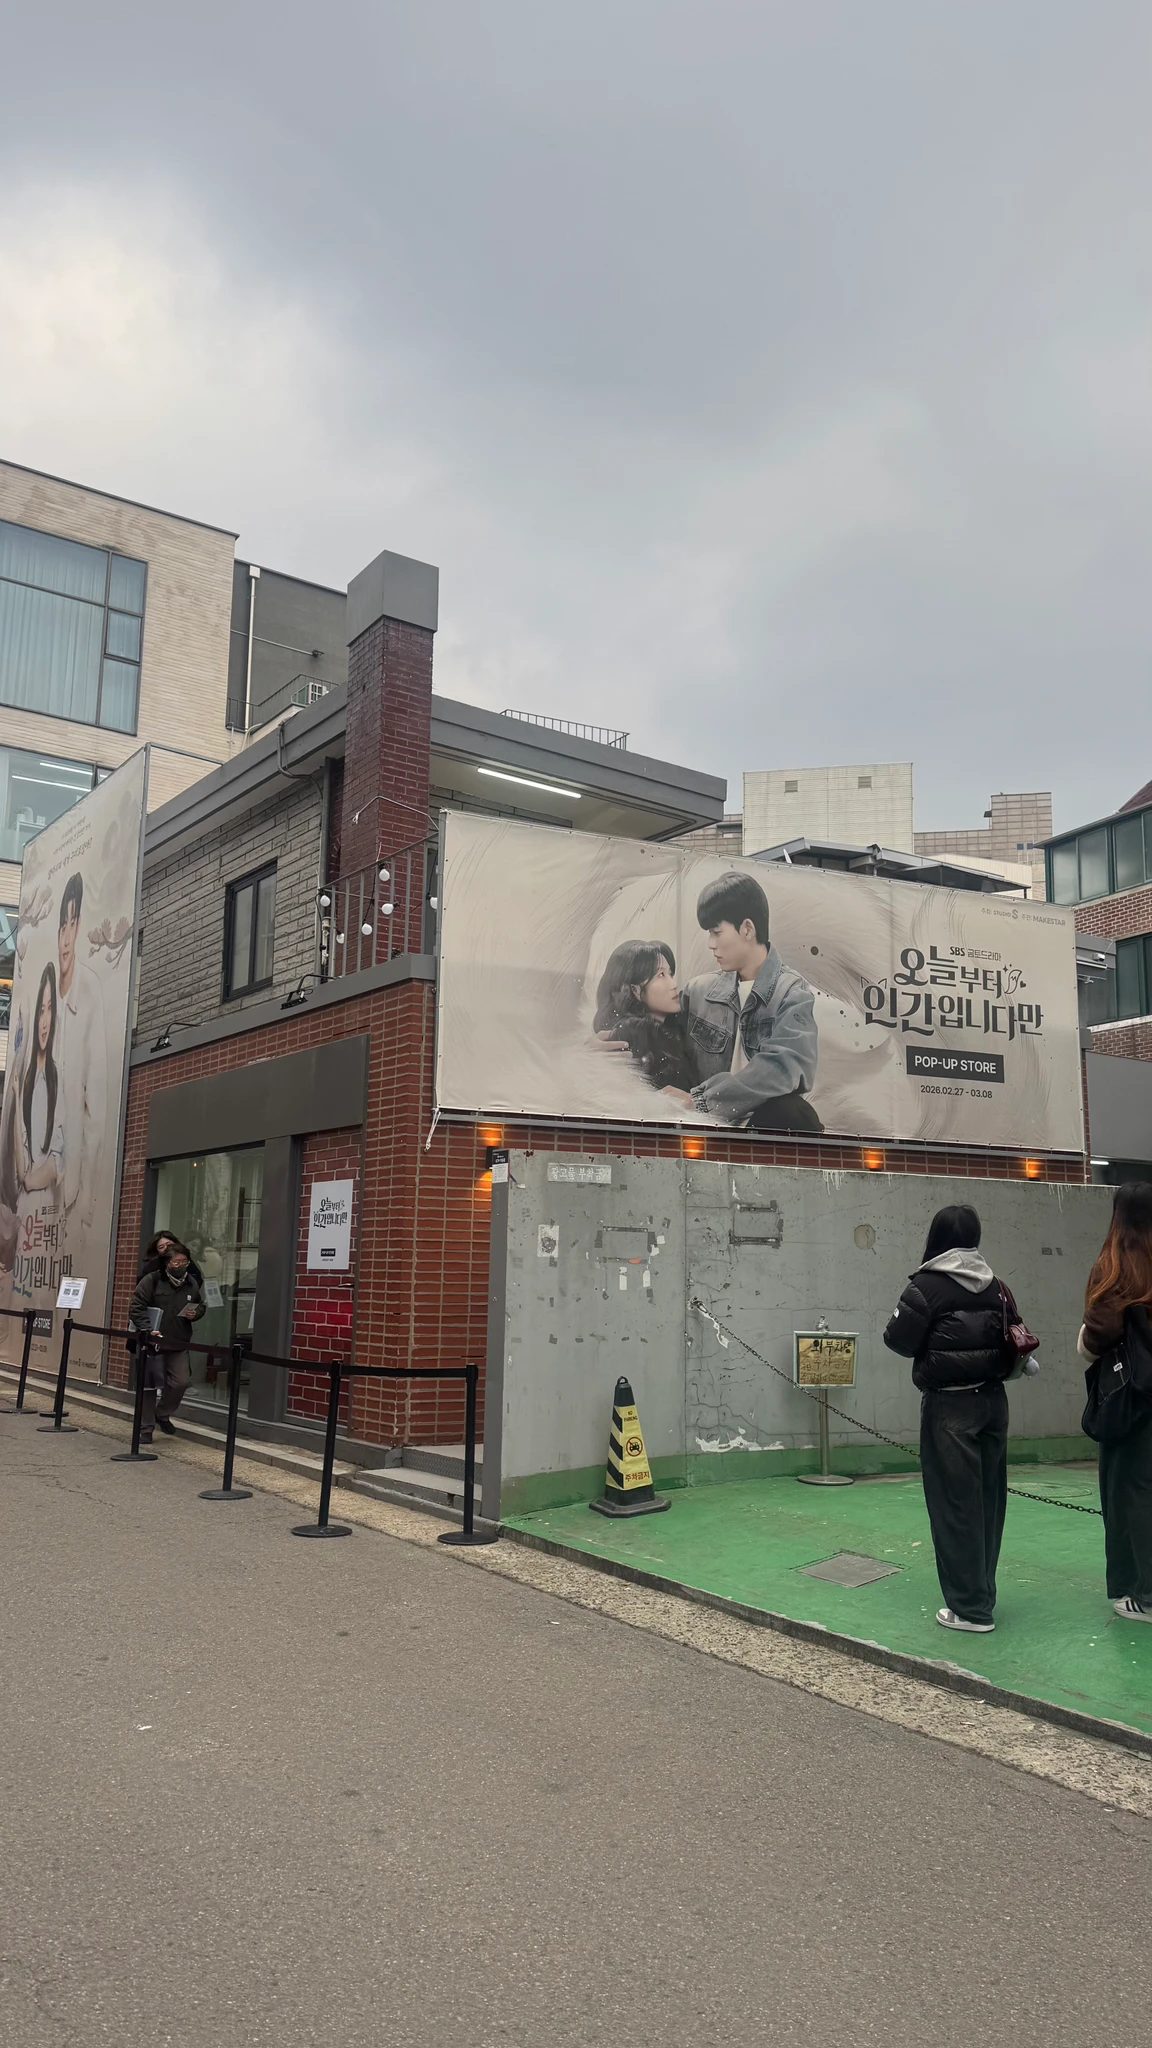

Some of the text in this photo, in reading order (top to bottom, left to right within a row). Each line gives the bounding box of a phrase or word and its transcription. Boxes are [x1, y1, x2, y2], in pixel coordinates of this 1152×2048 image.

[993, 909, 1011, 918] STUDIO
[1033, 915, 1066, 926] MAKESTAR
[949, 946, 1001, 962] SBS 금토드라마
[893, 945, 1002, 999] 오늘부터
[863, 983, 1044, 1042] 인간입니다만
[914, 1055, 997, 1074] POP-UP STORE
[920, 1084, 964, 1096] 2026.02.27
[970, 1088, 993, 1099] 03.08
[23, 1209, 59, 1253] 오늘부터
[625, 1471, 650, 1482] 주차금지
